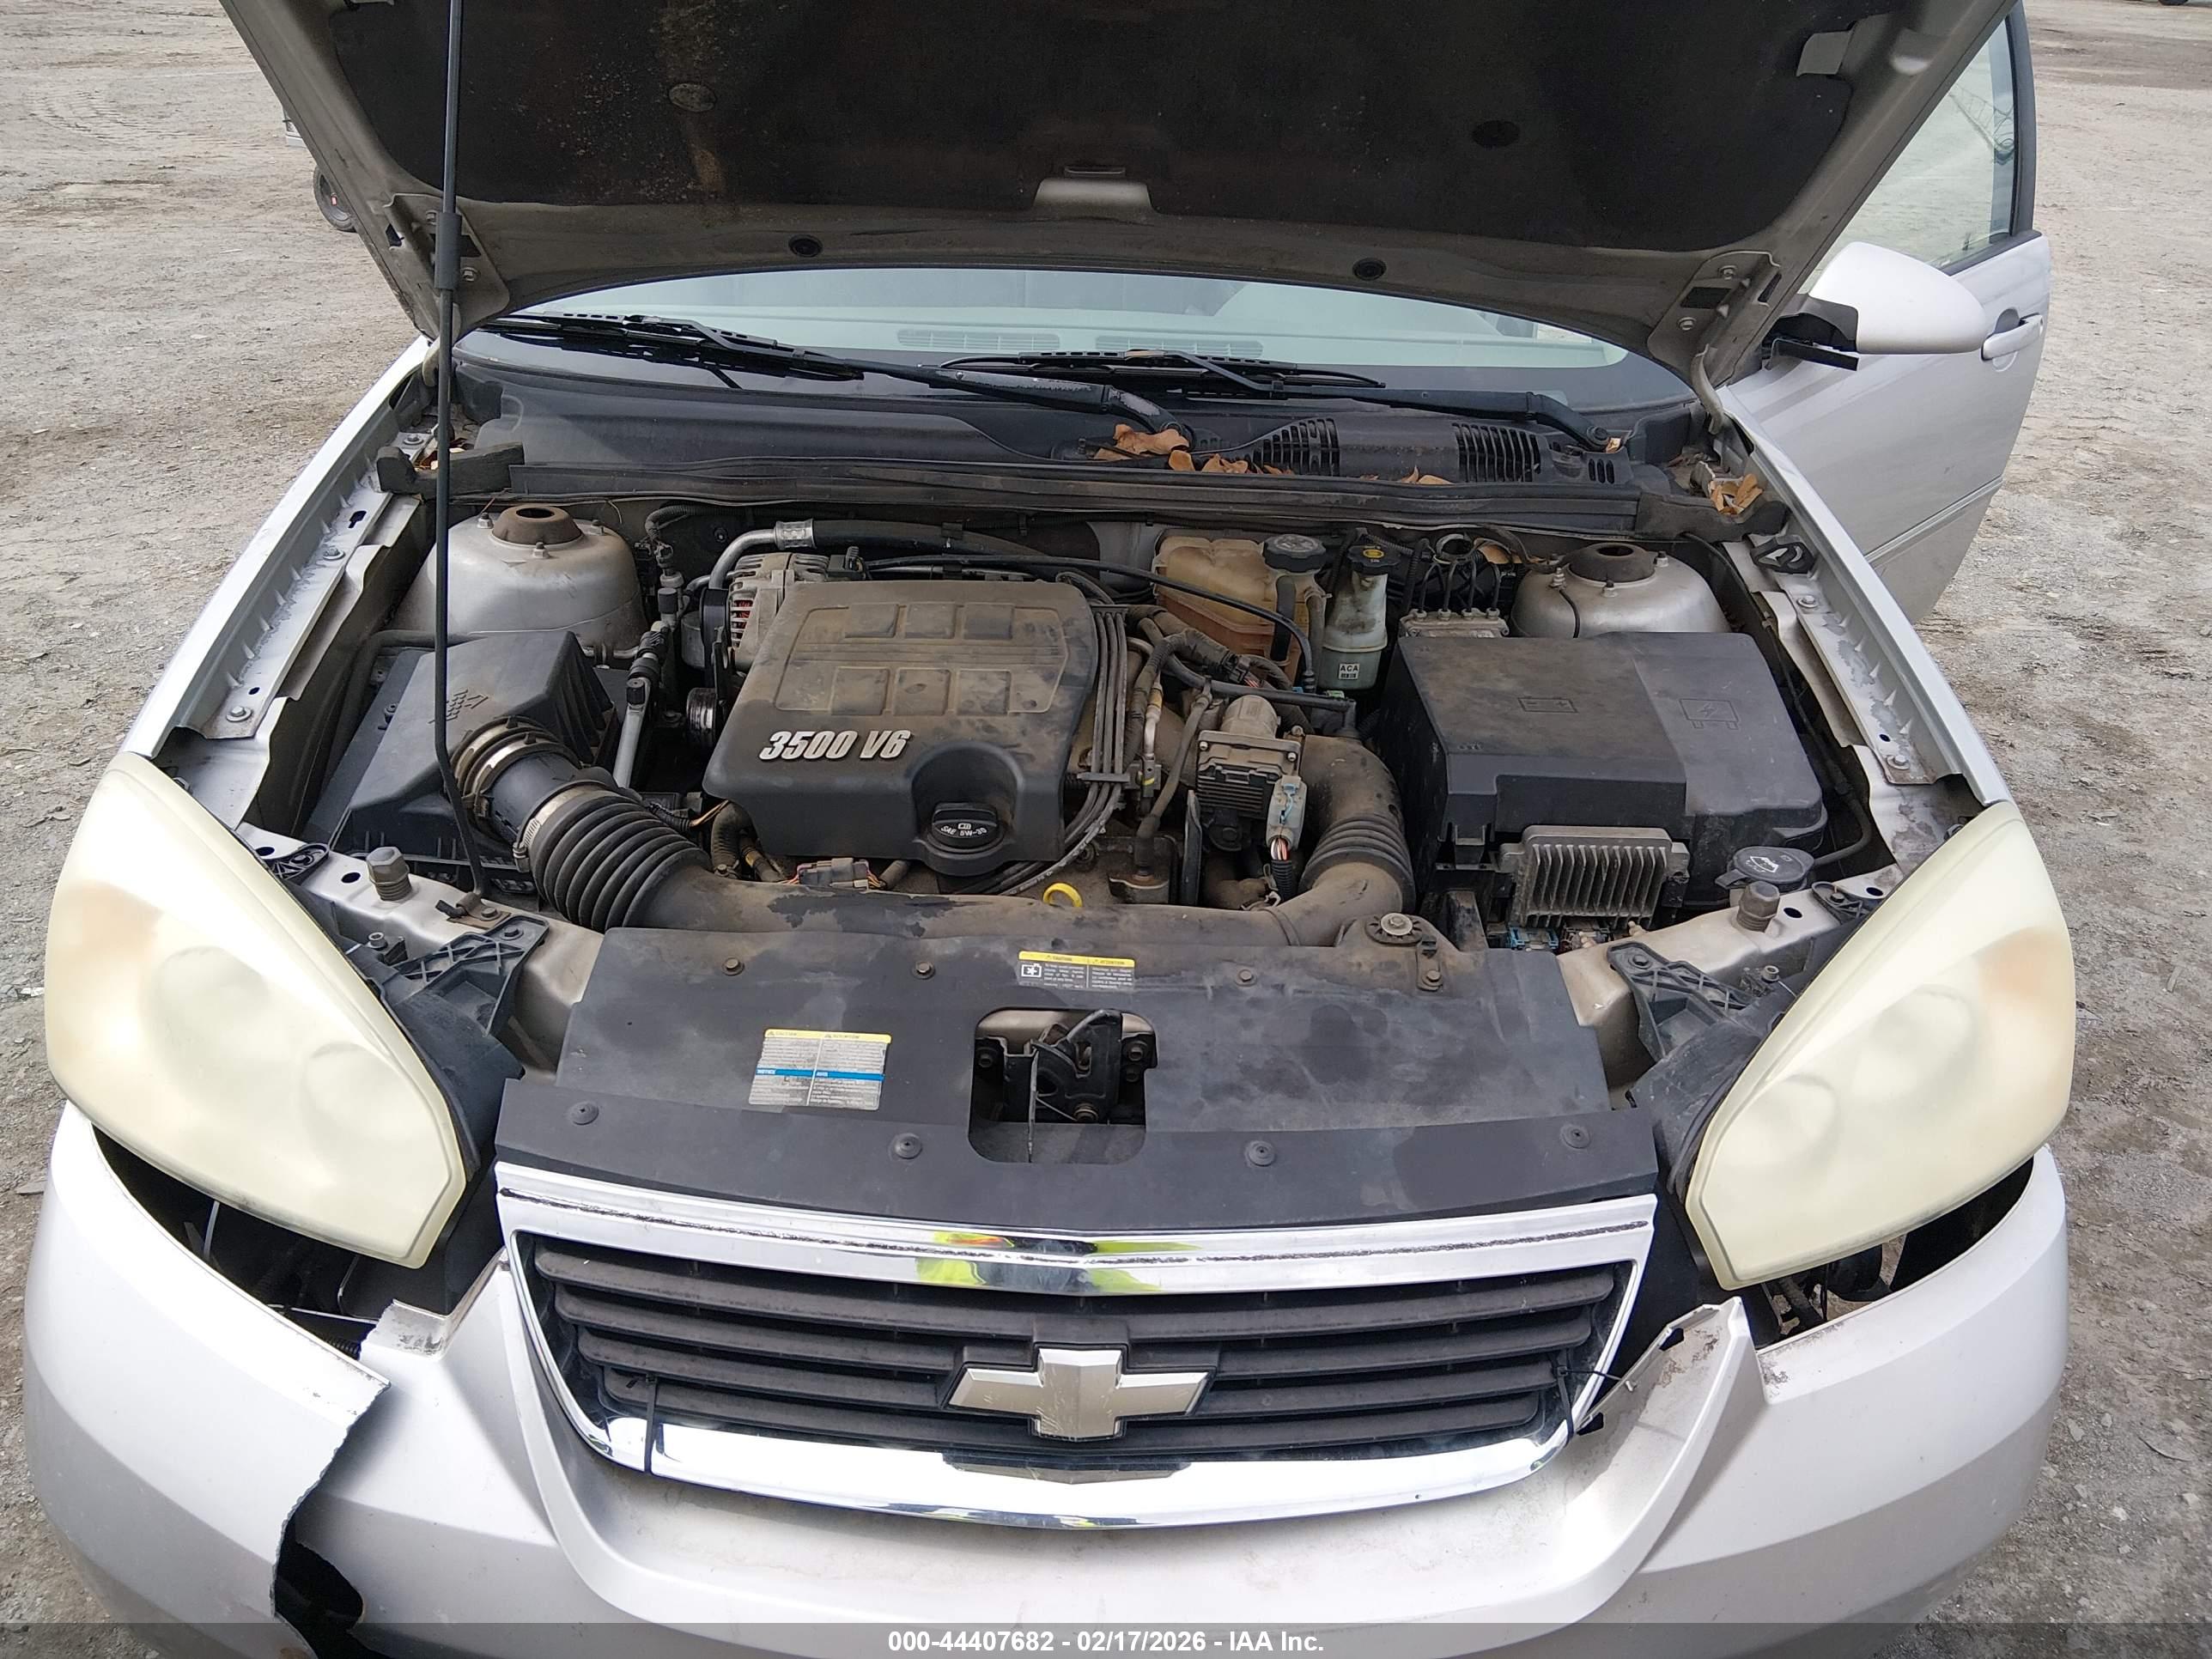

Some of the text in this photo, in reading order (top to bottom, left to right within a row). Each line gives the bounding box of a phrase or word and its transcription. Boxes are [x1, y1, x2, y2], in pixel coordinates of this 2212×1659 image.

[759, 730, 911, 760] 3500 V6
[940, 825, 988, 836] SAE 5W-30
